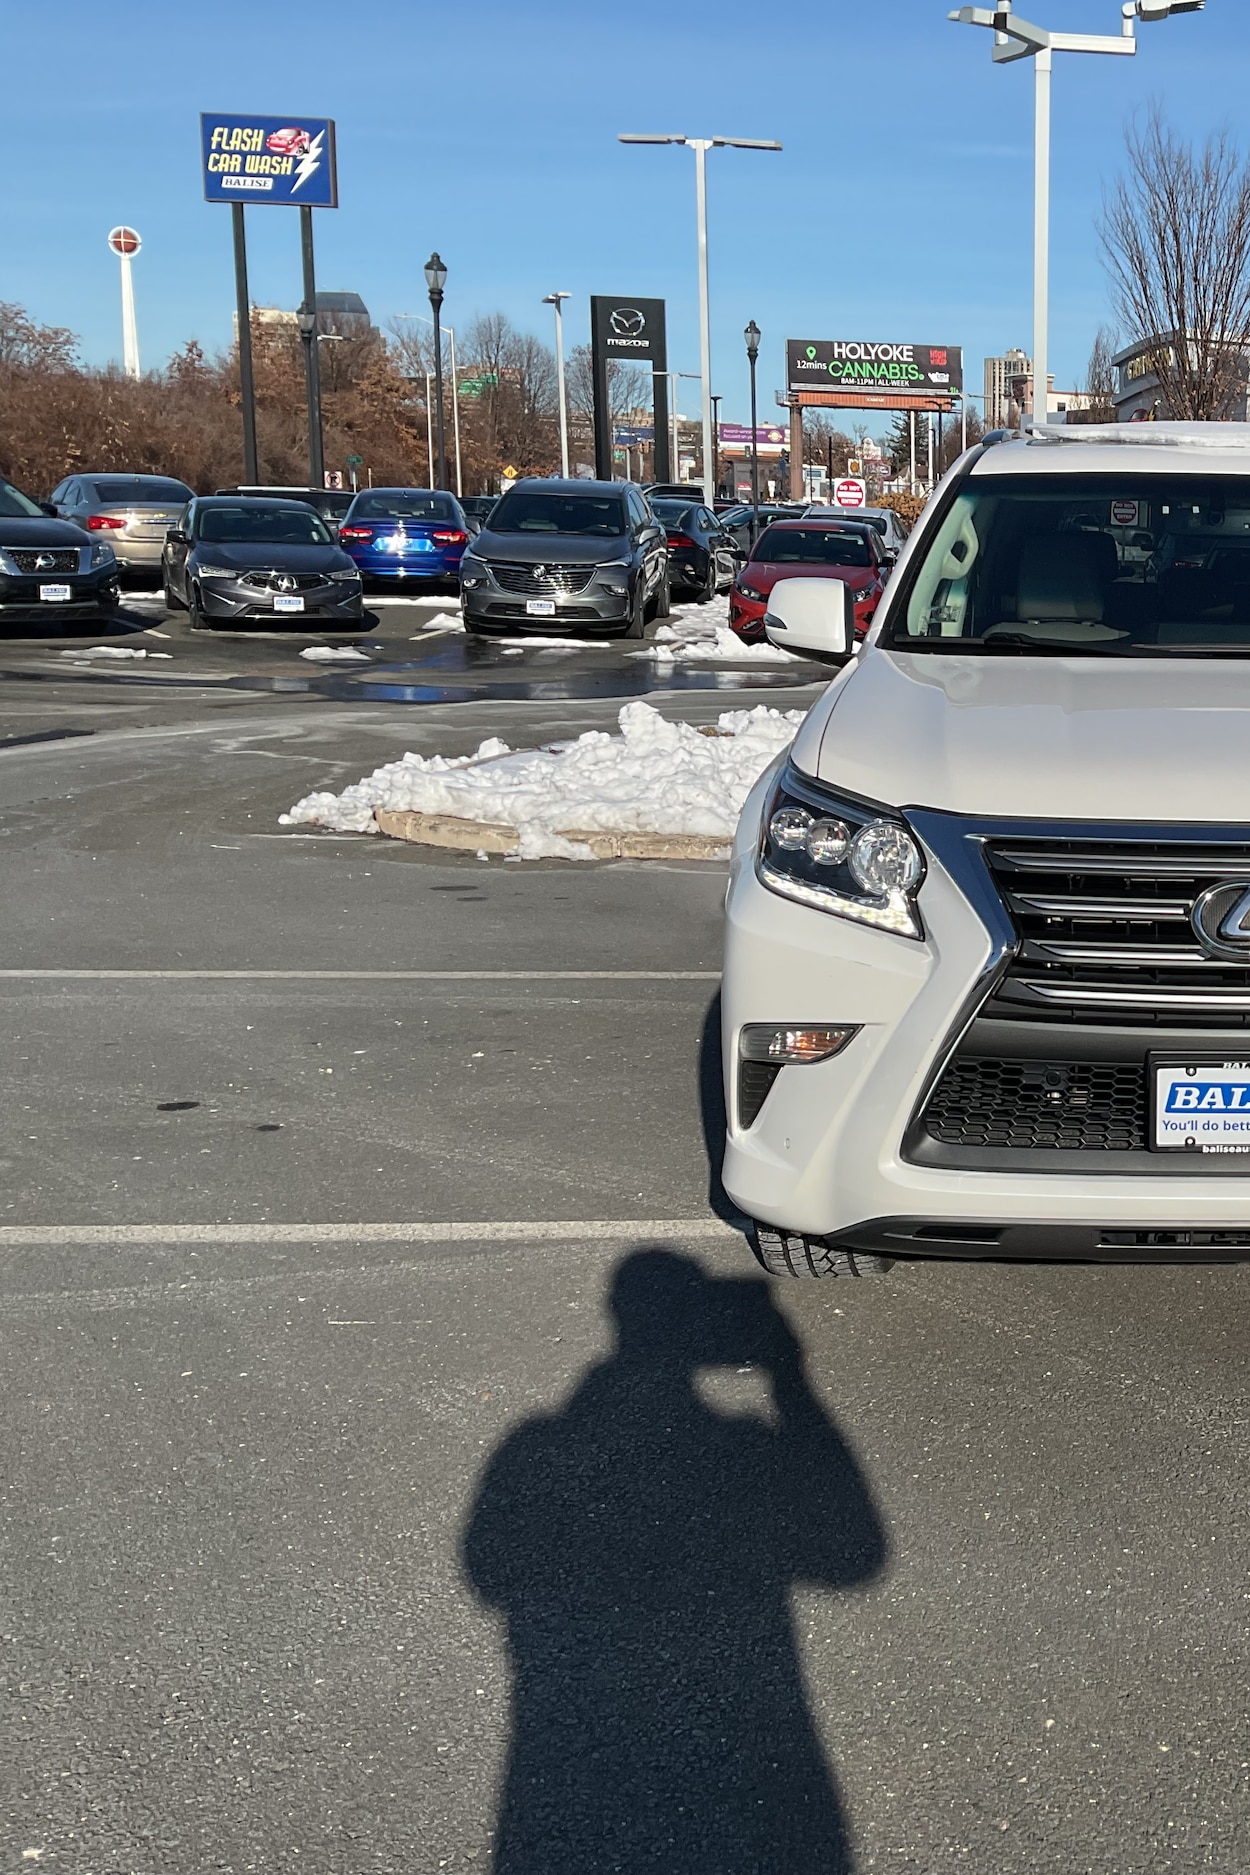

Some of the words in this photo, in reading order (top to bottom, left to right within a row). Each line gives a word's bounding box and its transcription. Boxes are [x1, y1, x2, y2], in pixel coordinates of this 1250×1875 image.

[211, 127, 264, 151] FLASH
[208, 153, 241, 173] CAR
[244, 155, 293, 175] WASH
[225, 177, 270, 187] BALISE
[607, 339, 650, 347] mazda
[833, 342, 913, 361] HOLYOKE
[796, 360, 828, 370] 12mins
[1202, 1119, 1219, 1131] do
